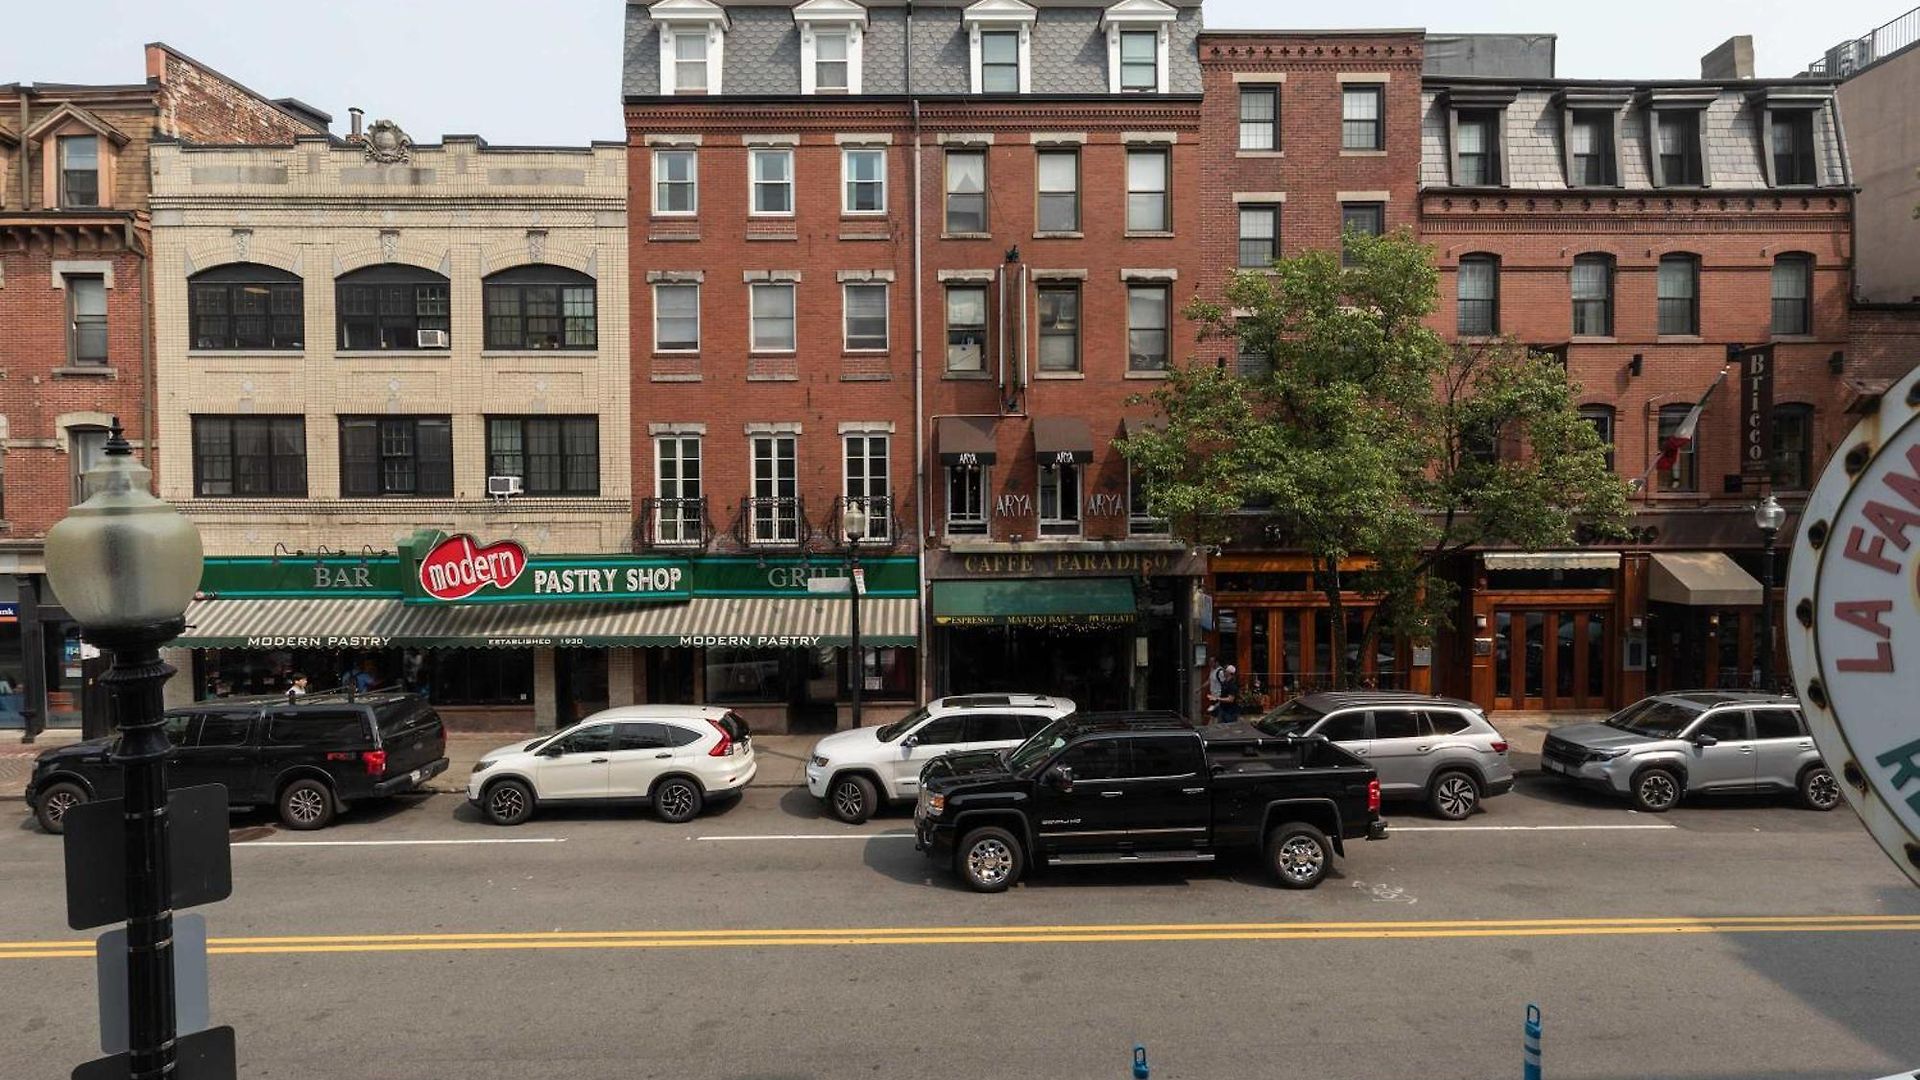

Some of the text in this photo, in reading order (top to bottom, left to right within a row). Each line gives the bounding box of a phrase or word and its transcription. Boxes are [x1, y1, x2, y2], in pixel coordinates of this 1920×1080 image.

[1750, 353, 1764, 460] Bricco
[959, 453, 977, 464] ARYA
[1056, 451, 1074, 463] ARYA
[996, 494, 1033, 517] ARYA
[1087, 493, 1123, 518] ARYA
[428, 538, 516, 592] modern
[1056, 552, 1169, 571] PARADIO
[314, 567, 373, 588] BAR
[534, 567, 682, 593] PASTRY SHOP
[951, 616, 995, 625] ESPRESSO
[247, 637, 391, 646] MODERN PASTRY
[488, 637, 583, 646] ESTABLISHED 1930
[680, 636, 820, 646] MODERN PASTRY
[1834, 600, 1895, 672] LA
